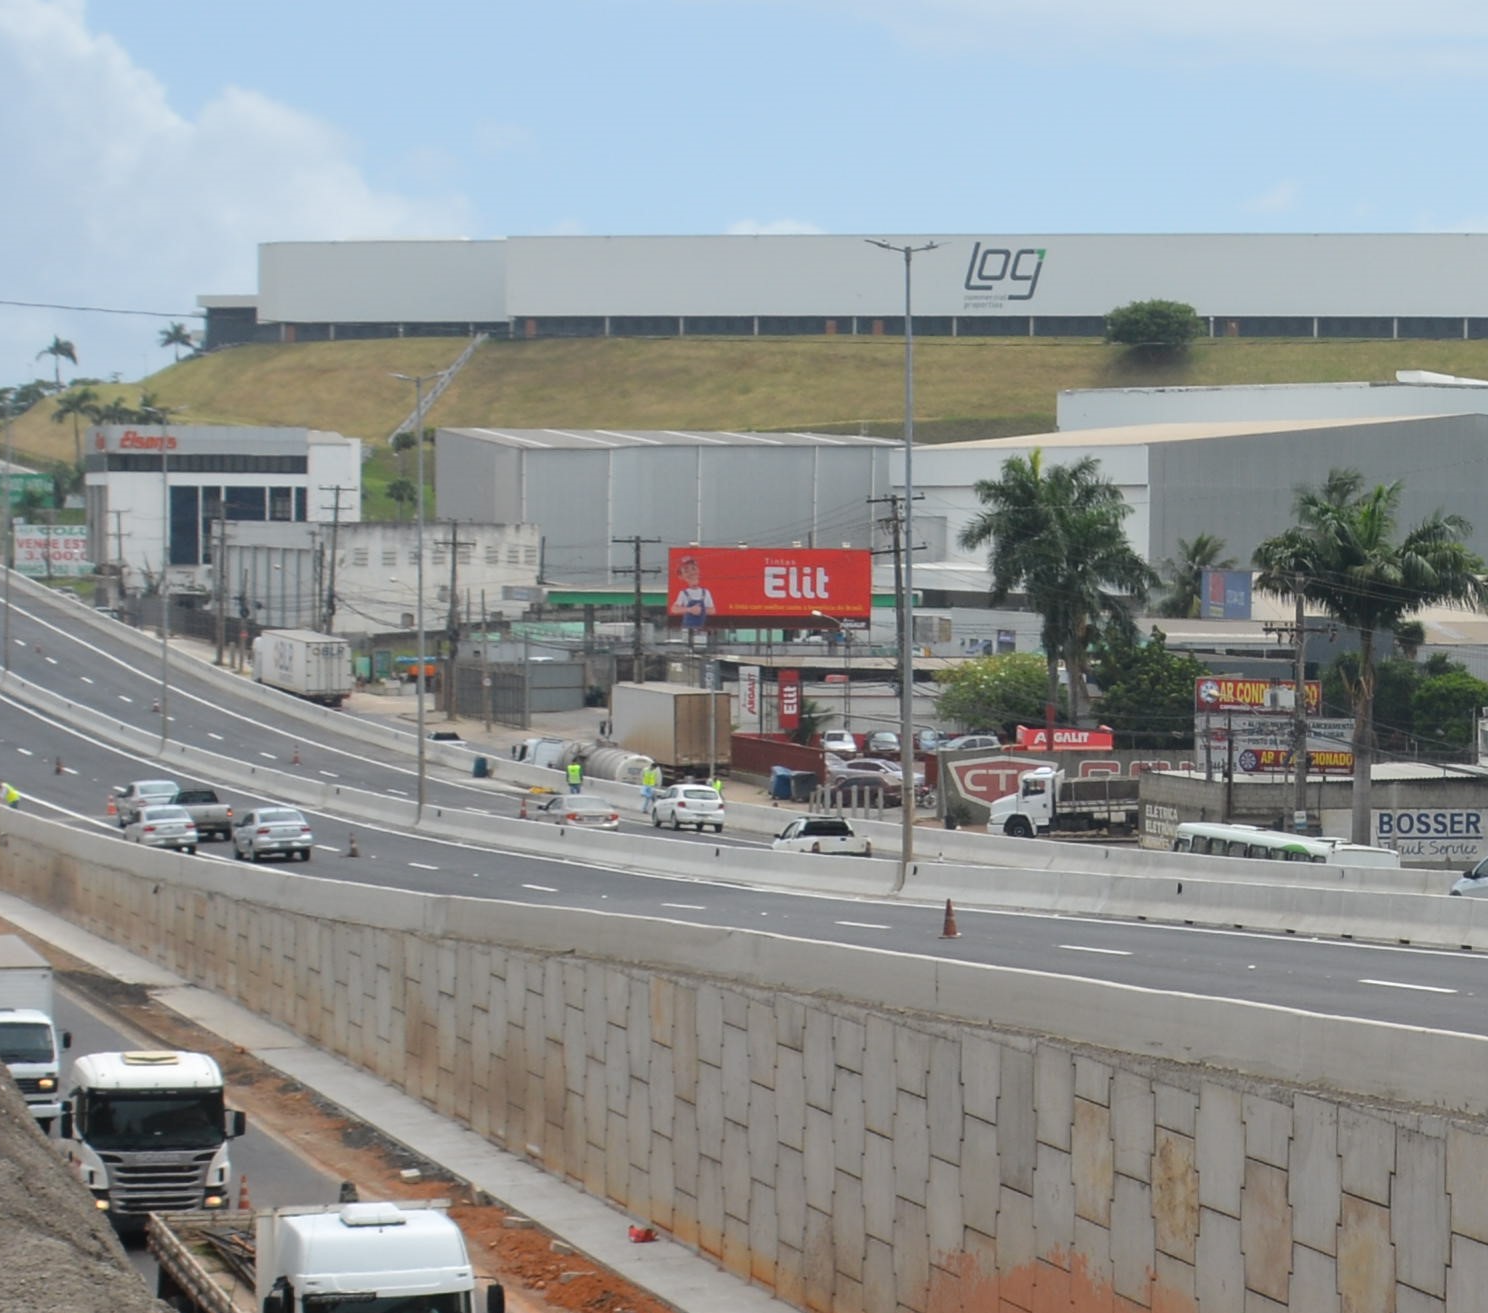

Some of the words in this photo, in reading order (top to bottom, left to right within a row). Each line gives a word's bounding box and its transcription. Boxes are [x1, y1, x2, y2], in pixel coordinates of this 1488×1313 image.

[763, 566, 830, 600] Elit
[783, 684, 798, 715] Elit
[1219, 682, 1234, 703] AR
[1034, 731, 1089, 744] AGALIT
[1261, 752, 1274, 764] AR
[1378, 812, 1481, 834] BOSSER
[1429, 840, 1478, 856] Service
